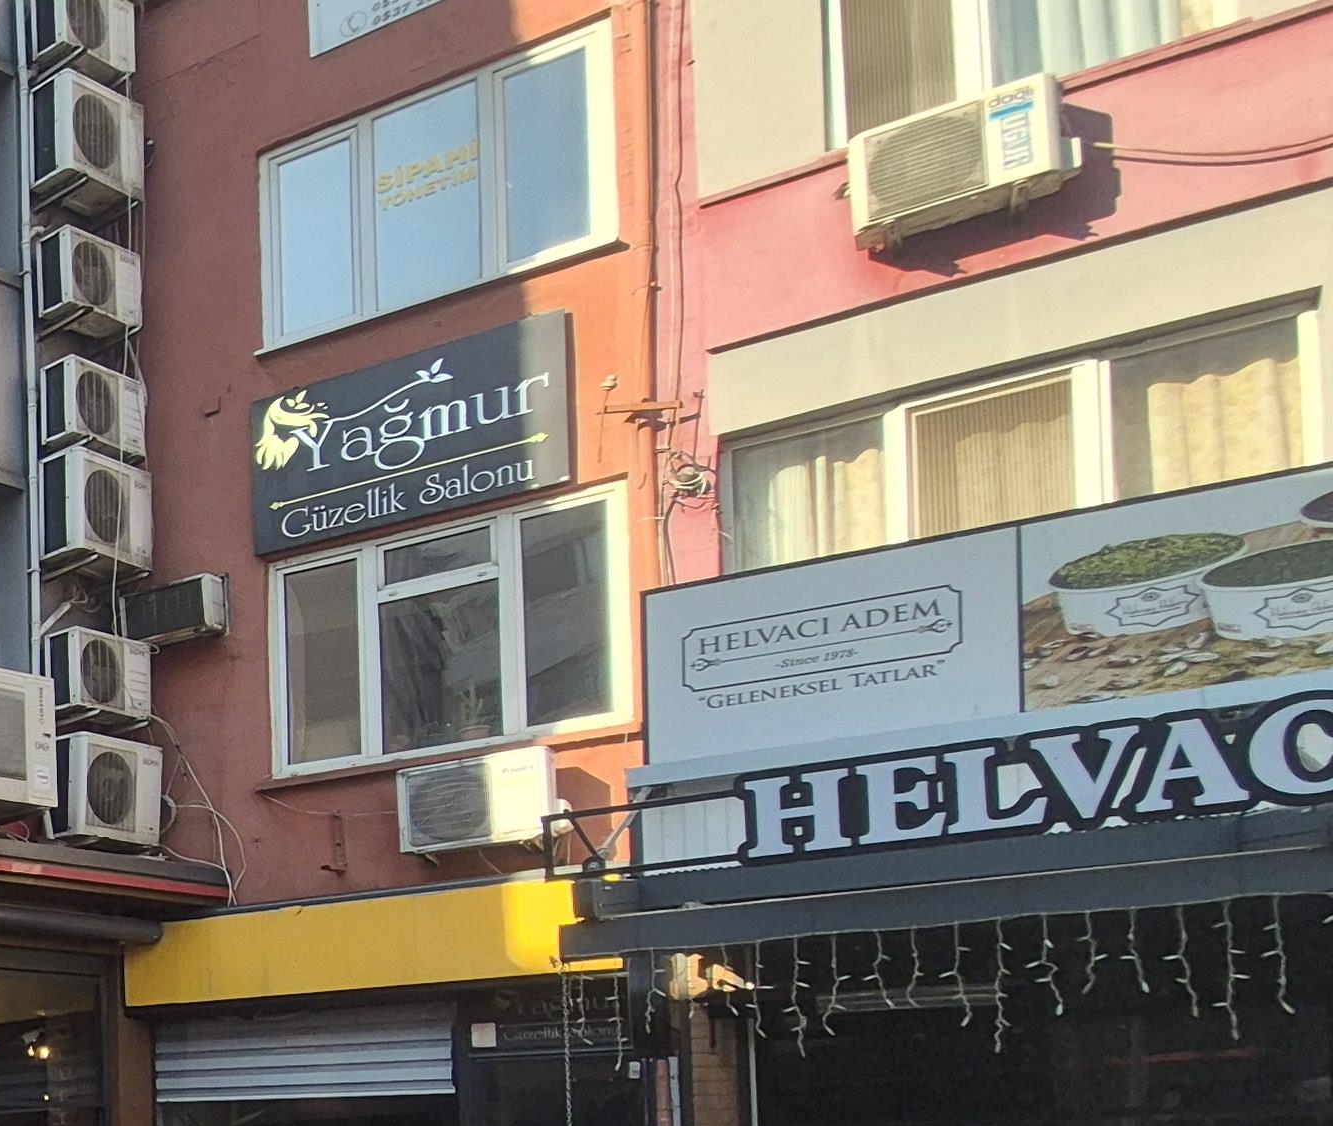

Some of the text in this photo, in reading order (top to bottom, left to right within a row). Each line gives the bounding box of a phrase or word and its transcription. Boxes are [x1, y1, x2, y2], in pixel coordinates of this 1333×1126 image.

[294, 372, 551, 471] Yağmur
[282, 457, 535, 539] Güzellik Salonu
[699, 599, 942, 655] HELVACI ADEM
